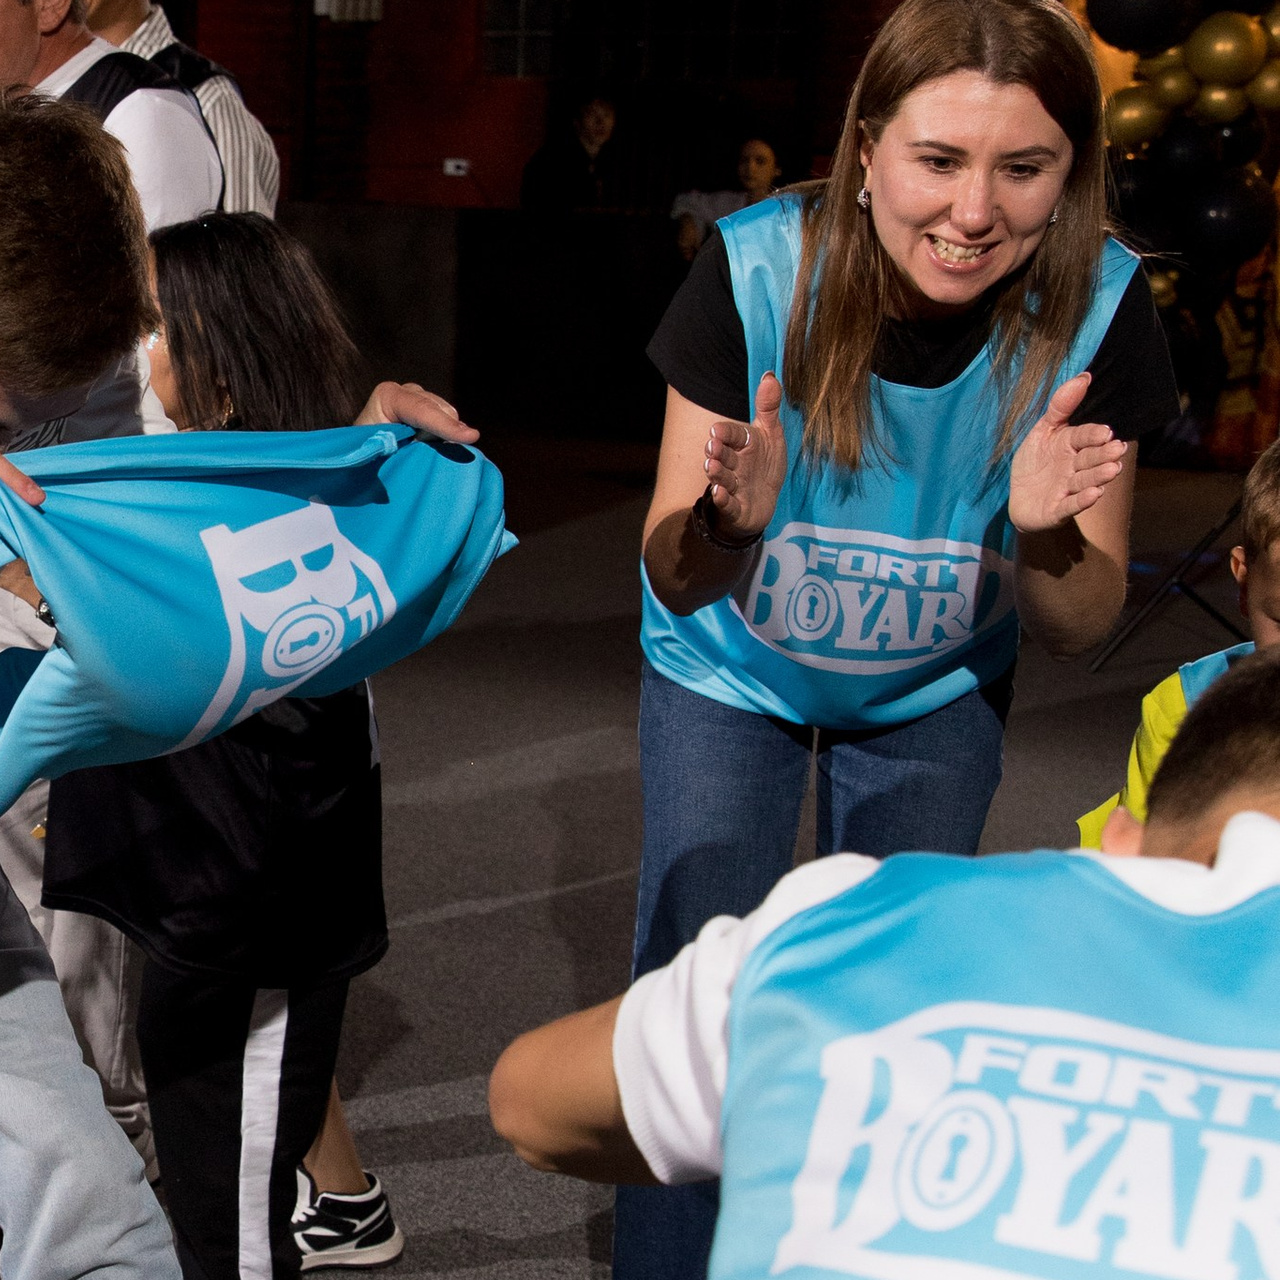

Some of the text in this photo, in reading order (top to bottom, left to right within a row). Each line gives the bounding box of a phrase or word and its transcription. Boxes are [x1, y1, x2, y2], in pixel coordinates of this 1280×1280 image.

[744, 540, 1016, 652] BOYARD
[806, 543, 950, 589] FORT
[955, 1033, 1276, 1127] FORT
